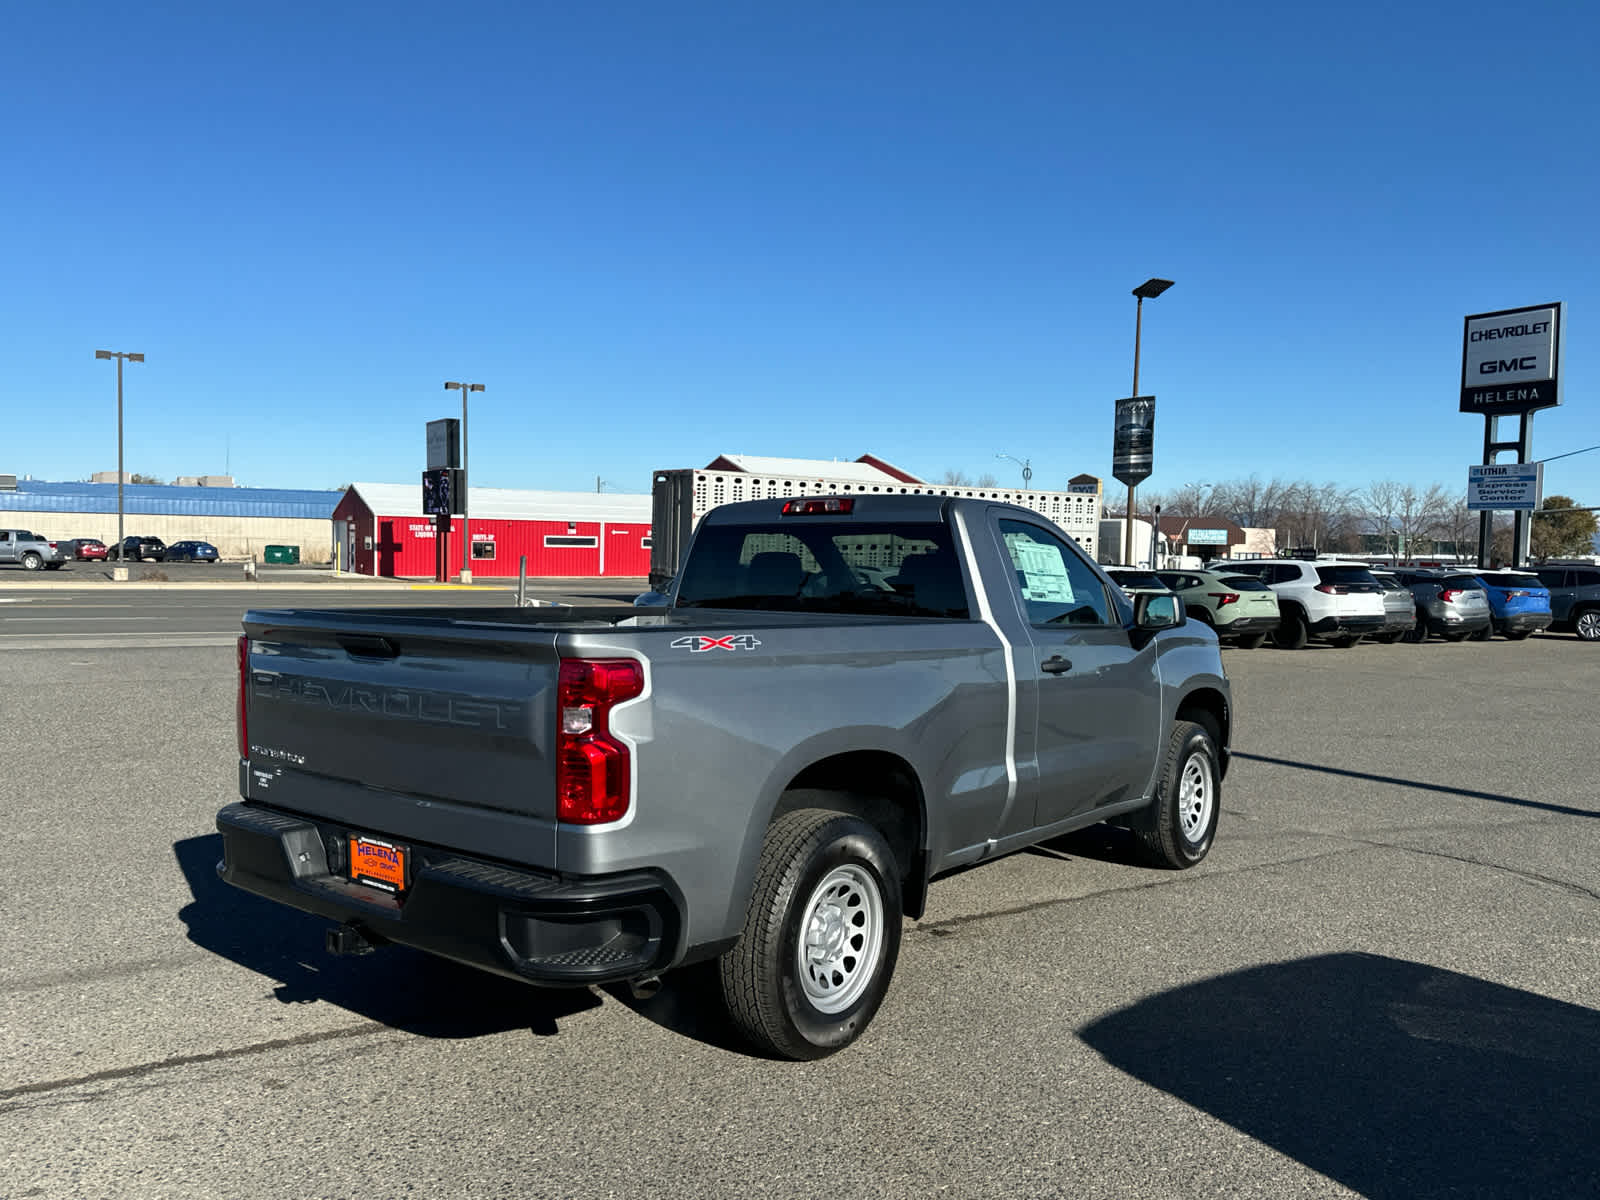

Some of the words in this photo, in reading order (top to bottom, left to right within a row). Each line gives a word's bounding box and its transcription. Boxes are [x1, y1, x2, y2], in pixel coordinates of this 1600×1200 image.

[1470, 321, 1550, 342] CHEVROLET
[1480, 356, 1537, 374] GMC
[1473, 388, 1539, 404] HELENA
[253, 672, 522, 729] CHEVROLET
[357, 843, 401, 866] HELENA
